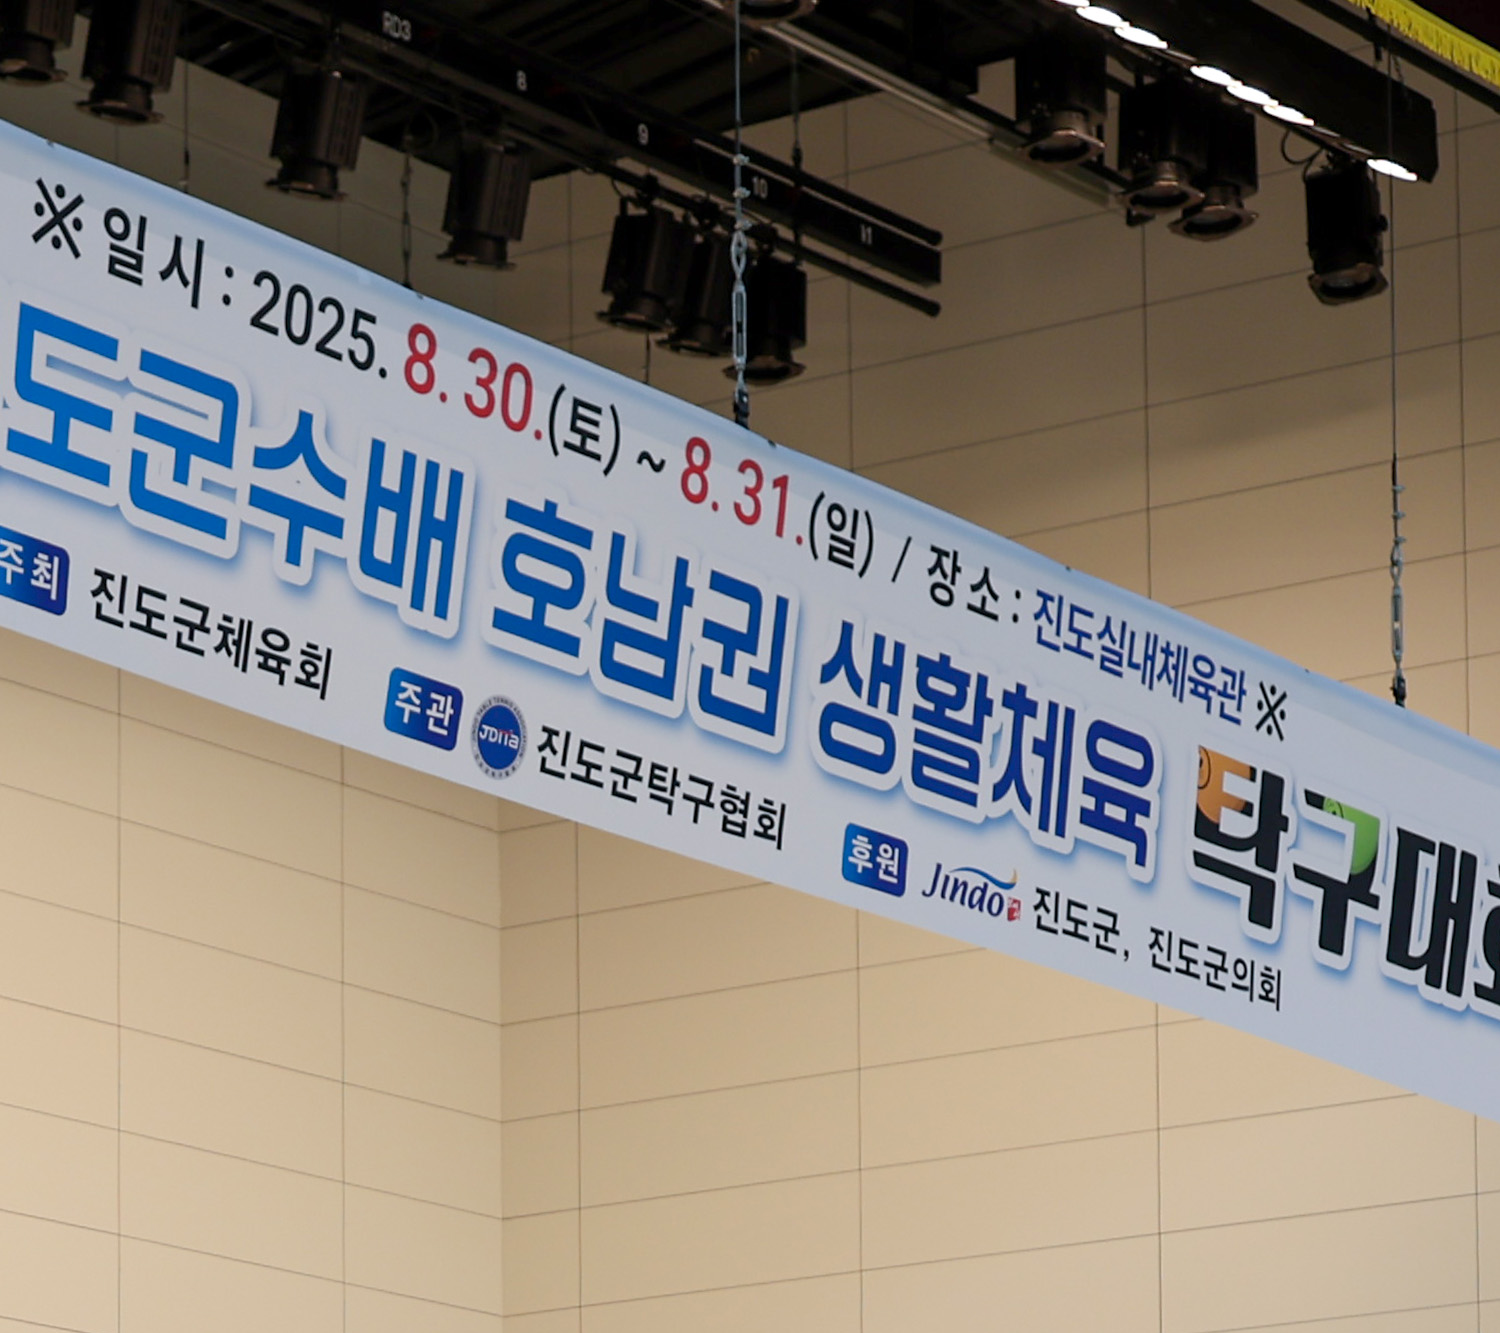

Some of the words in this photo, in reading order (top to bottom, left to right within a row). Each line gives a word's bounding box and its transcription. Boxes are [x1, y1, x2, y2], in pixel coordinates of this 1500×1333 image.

[90, 565, 333, 699] 진도군체육회
[486, 494, 791, 738] 호남권
[817, 619, 1157, 867] 생활체육
[1034, 589, 1247, 726] 진도실내체육관
[395, 680, 455, 736] 주관
[536, 725, 786, 850] 진도군탁구협회
[848, 835, 900, 884] 후원
[922, 863, 1005, 918] Jindo
[1148, 925, 1282, 1011] 진도군의회
